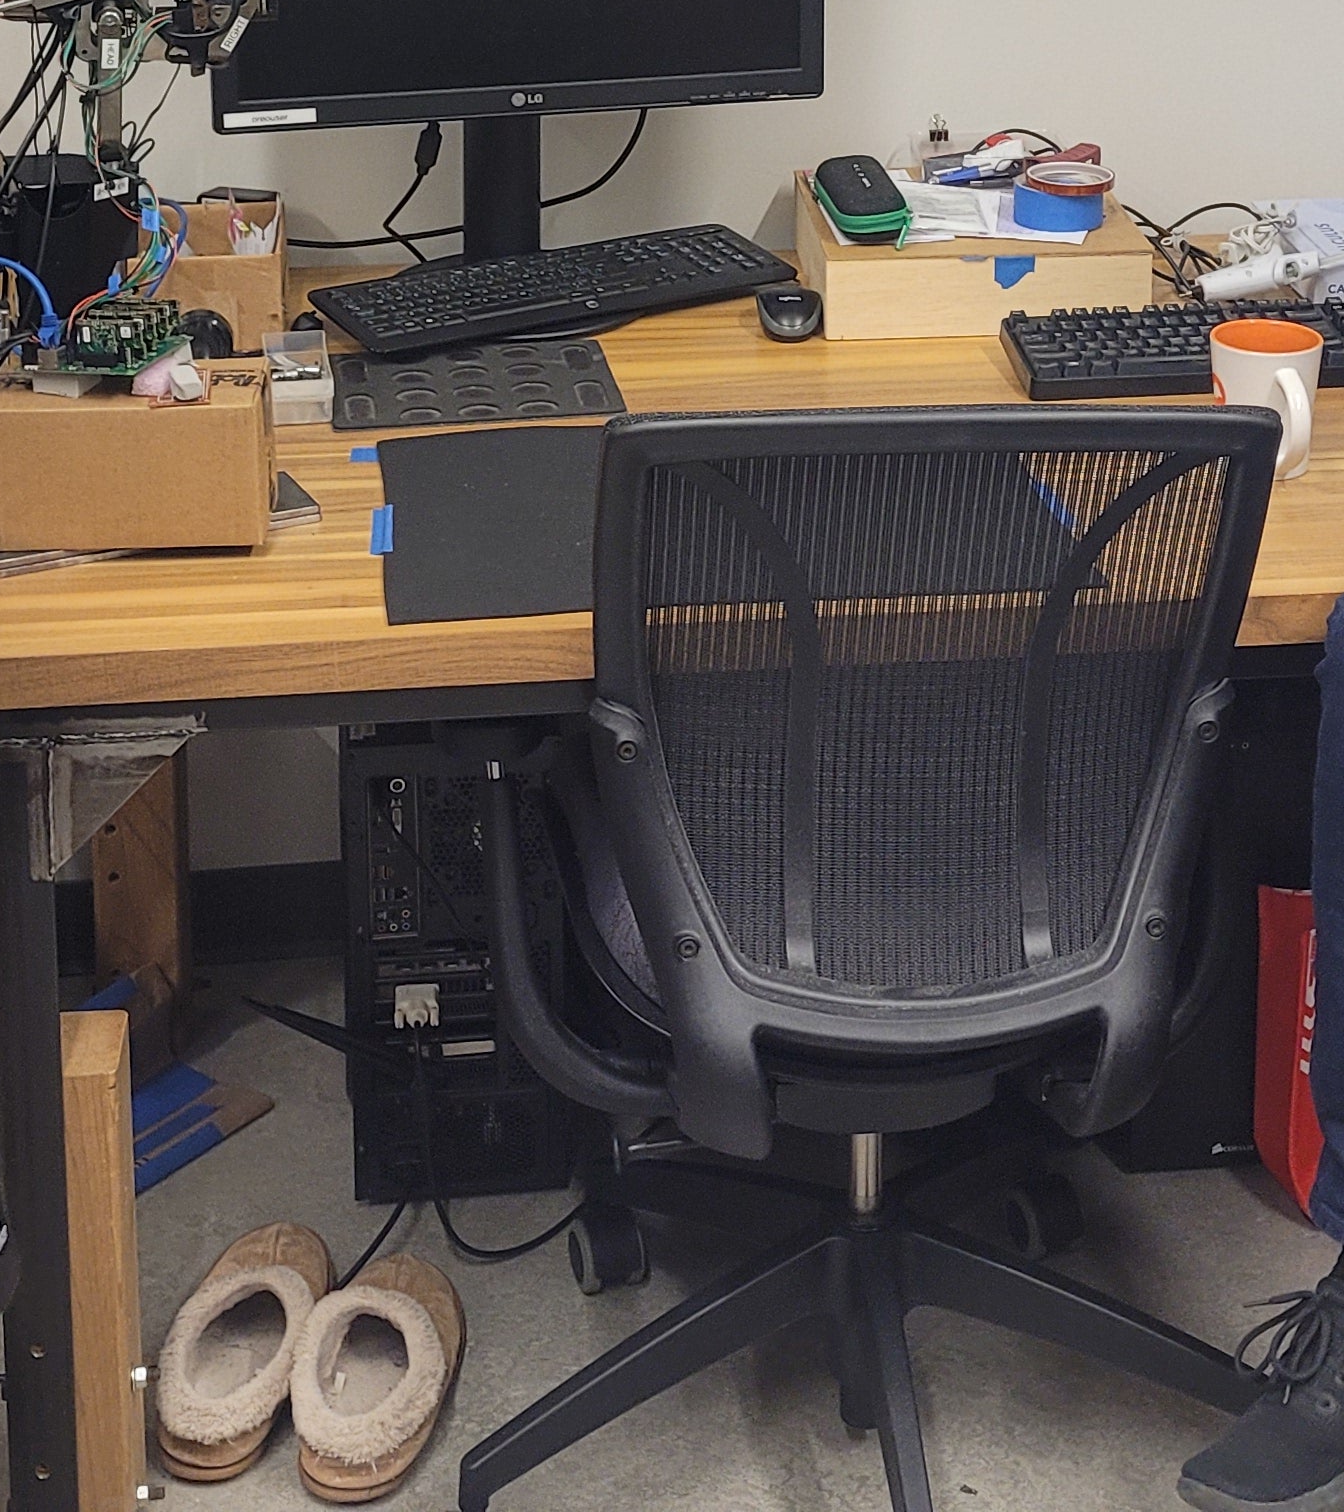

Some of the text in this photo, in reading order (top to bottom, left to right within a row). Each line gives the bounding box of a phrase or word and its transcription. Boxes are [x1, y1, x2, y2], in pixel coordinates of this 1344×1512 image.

[223, 19, 247, 49] RIGHT
[106, 43, 116, 65] HEAD
[527, 93, 544, 104] LG
